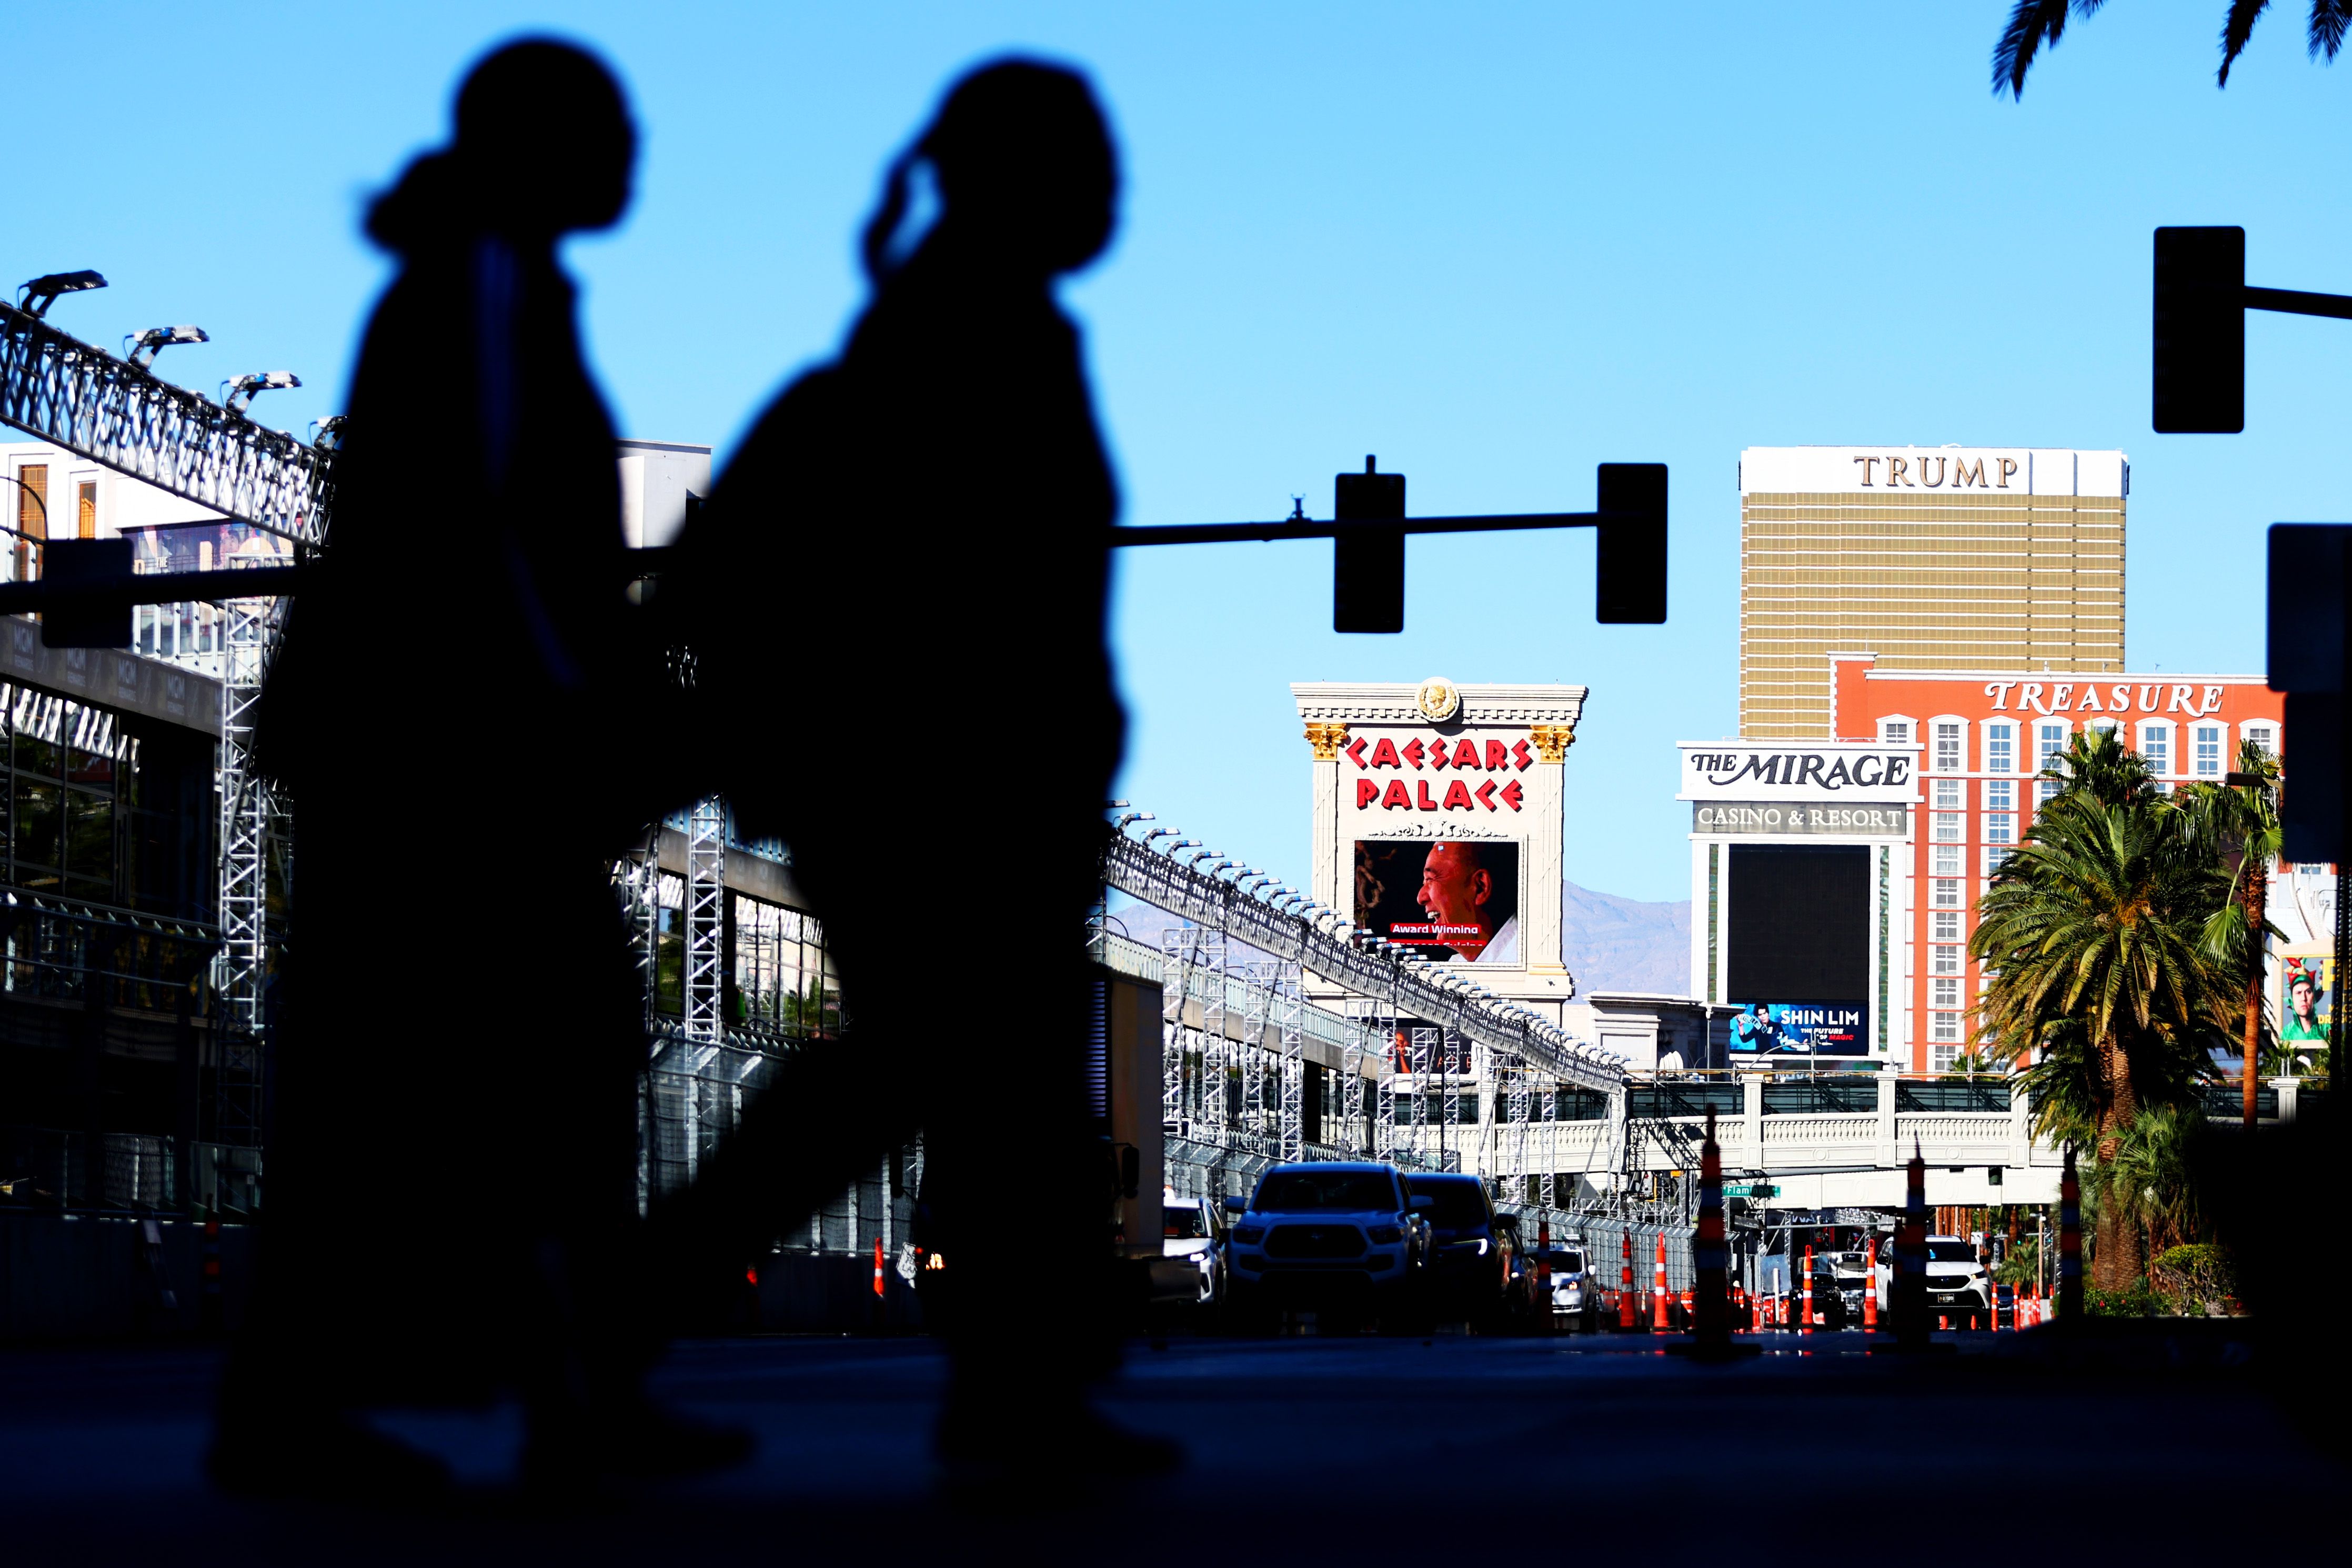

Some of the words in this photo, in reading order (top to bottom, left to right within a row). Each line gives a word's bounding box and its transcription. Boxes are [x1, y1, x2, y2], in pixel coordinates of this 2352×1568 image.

[1854, 456, 2017, 488] TRUMP
[156, 556, 168, 568] THE
[1984, 681, 2224, 718] TREASURE
[1345, 737, 1534, 772] CAESARS
[1691, 754, 1737, 772] THE
[1708, 754, 1911, 790] MIRAGE
[1356, 778, 1524, 813] PALACE
[1698, 808, 1781, 826] CASINO
[1788, 810, 1804, 826] &
[1810, 809, 1902, 827] RESORT
[1392, 924, 1429, 933] Award
[1781, 1010, 1824, 1025] SHIN
[1828, 1010, 1858, 1026] LIM
[1727, 1185, 1768, 1196] Flamingo
